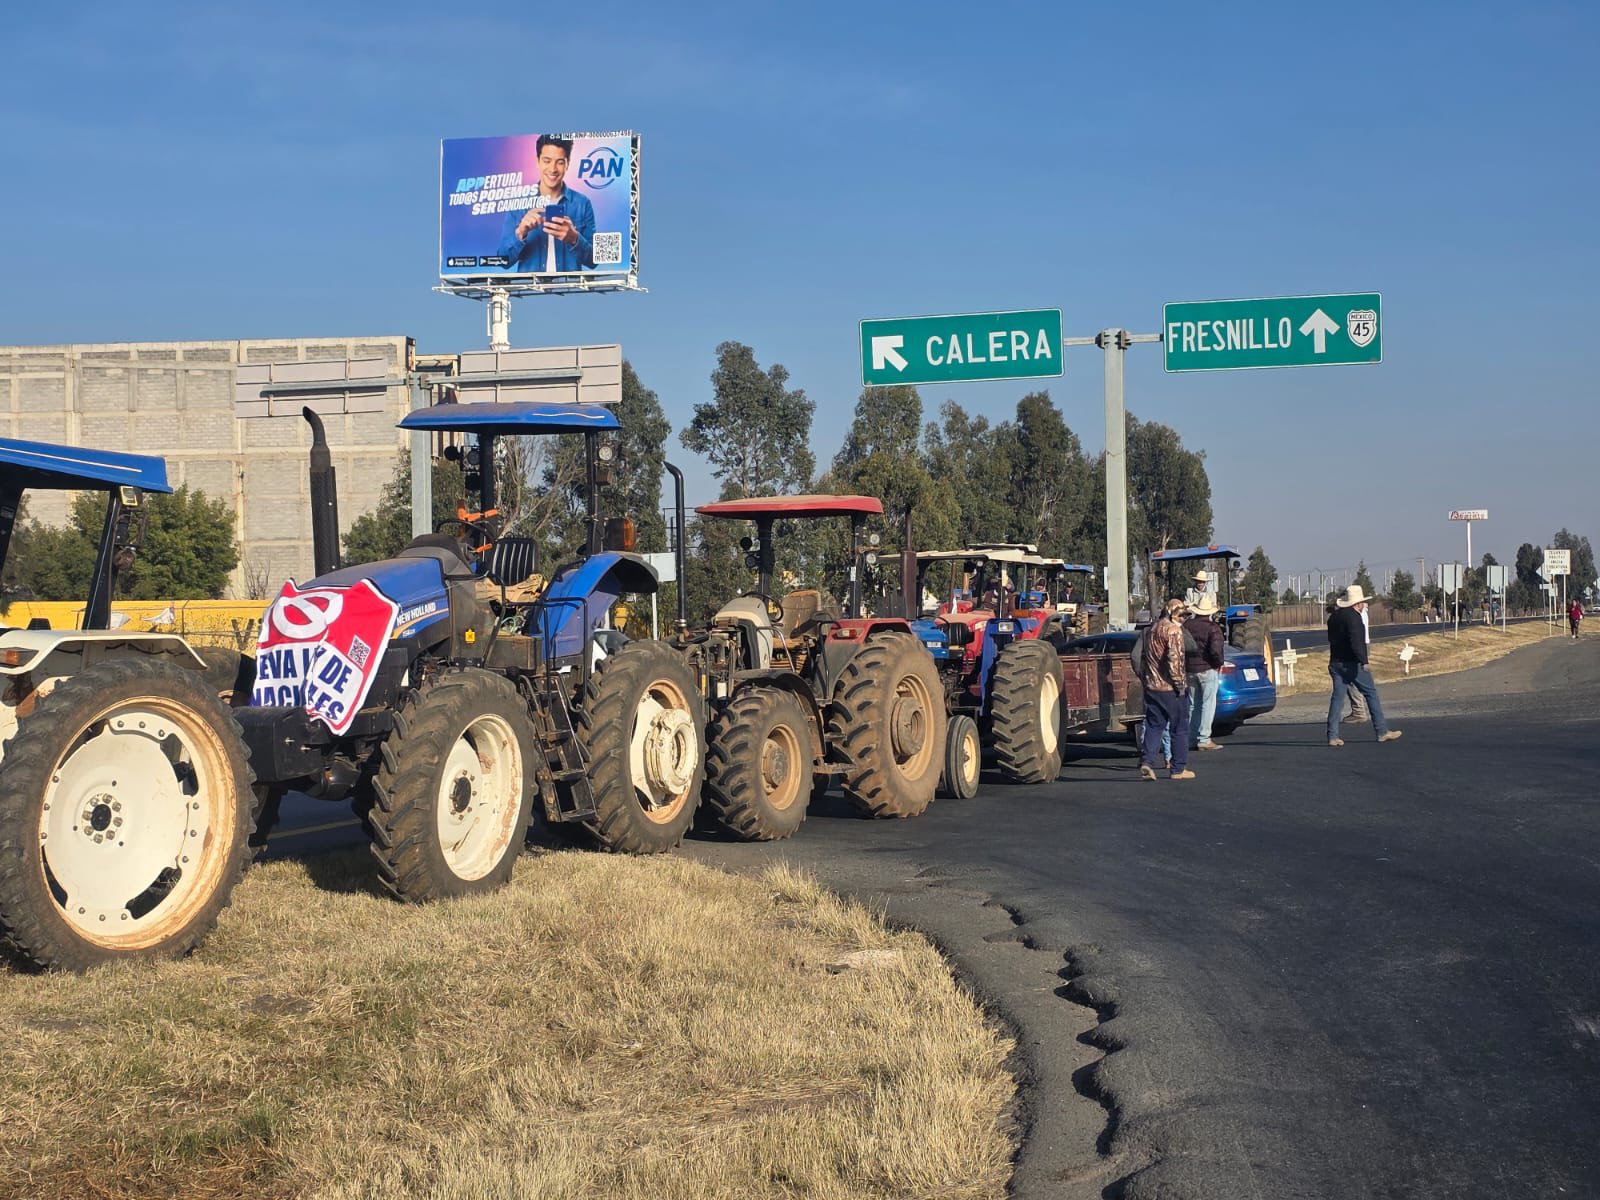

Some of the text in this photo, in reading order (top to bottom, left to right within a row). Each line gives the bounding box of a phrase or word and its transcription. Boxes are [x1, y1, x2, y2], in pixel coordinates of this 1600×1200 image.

[577, 157, 624, 179] PAN
[456, 172, 523, 193] APPERTURA
[449, 184, 539, 206] TOD@S PODEMOS
[471, 195, 552, 216] SER CANDIDAT@S
[1168, 317, 1292, 353] FRESNILLO
[1353, 322, 1370, 337] 45
[925, 329, 1052, 366] CALERA
[397, 602, 436, 626] NEW HOLLAND
